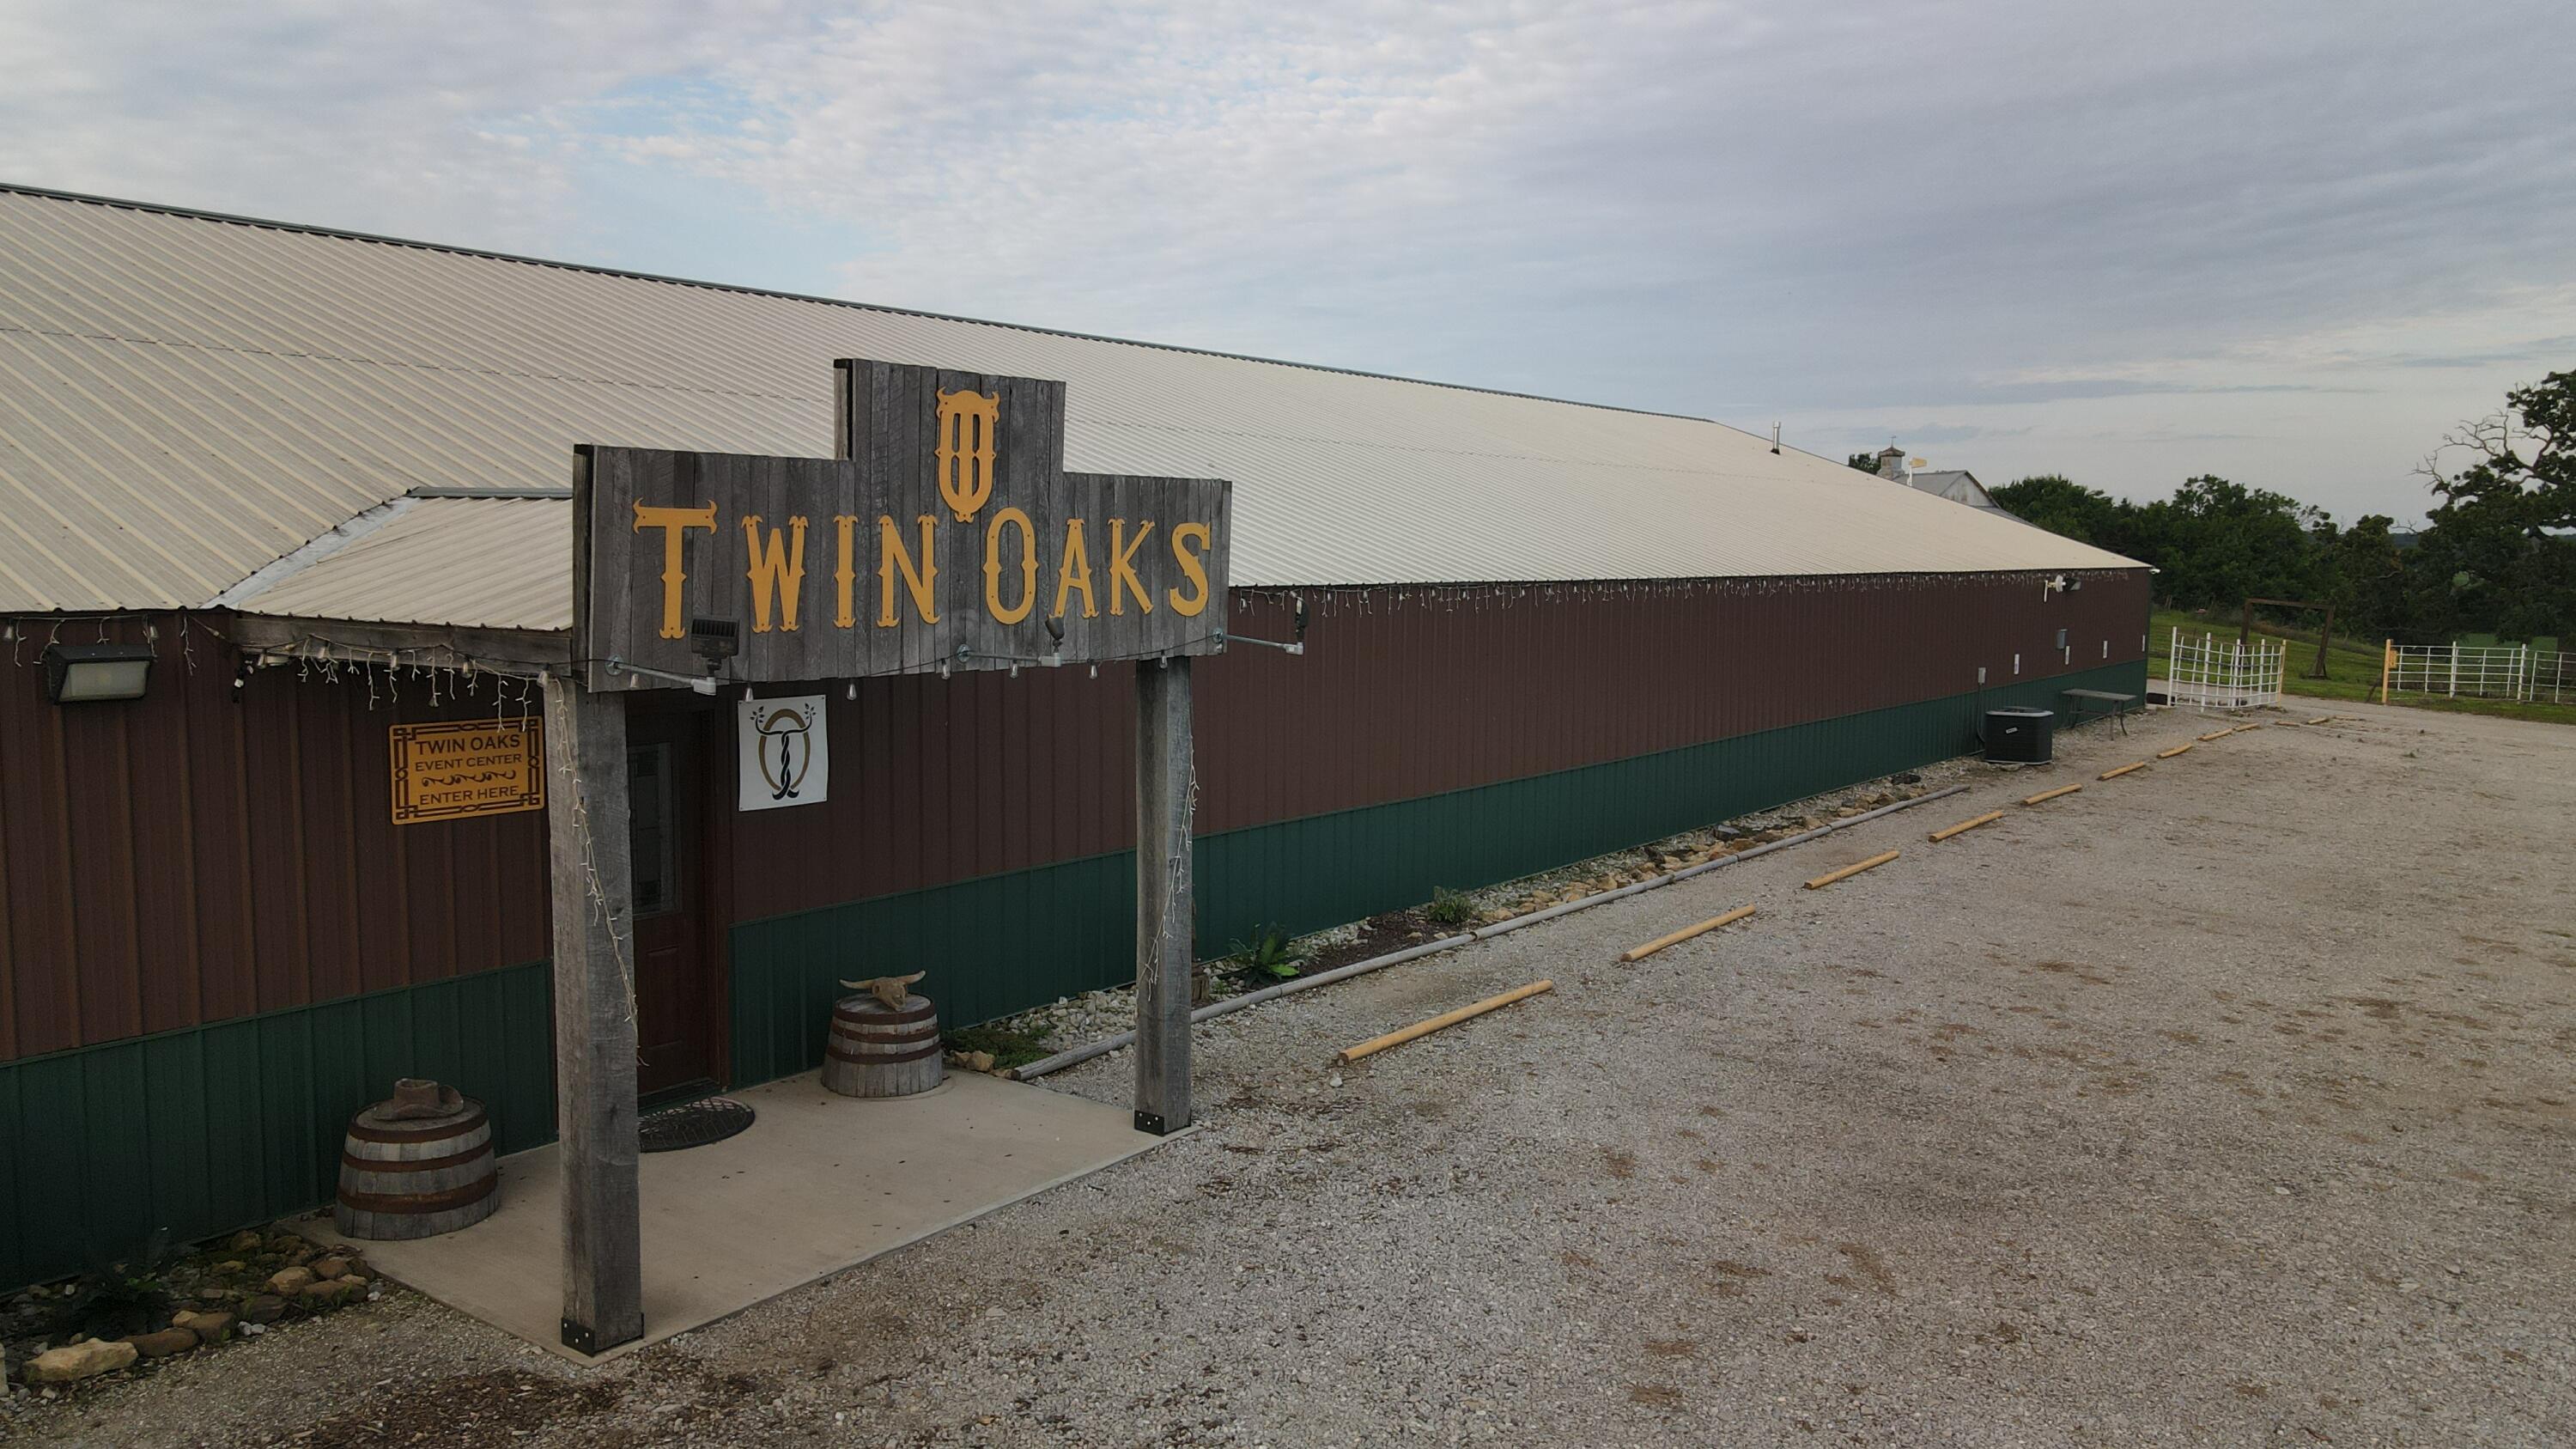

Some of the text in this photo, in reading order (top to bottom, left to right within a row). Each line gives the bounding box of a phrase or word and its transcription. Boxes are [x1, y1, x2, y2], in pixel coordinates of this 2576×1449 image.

[631, 498, 1212, 640] TWIN OAKS
[416, 734, 520, 755] TWIN OAKS
[416, 753, 522, 771] EVENT CENTER
[420, 786, 519, 805] ENTER HERE
